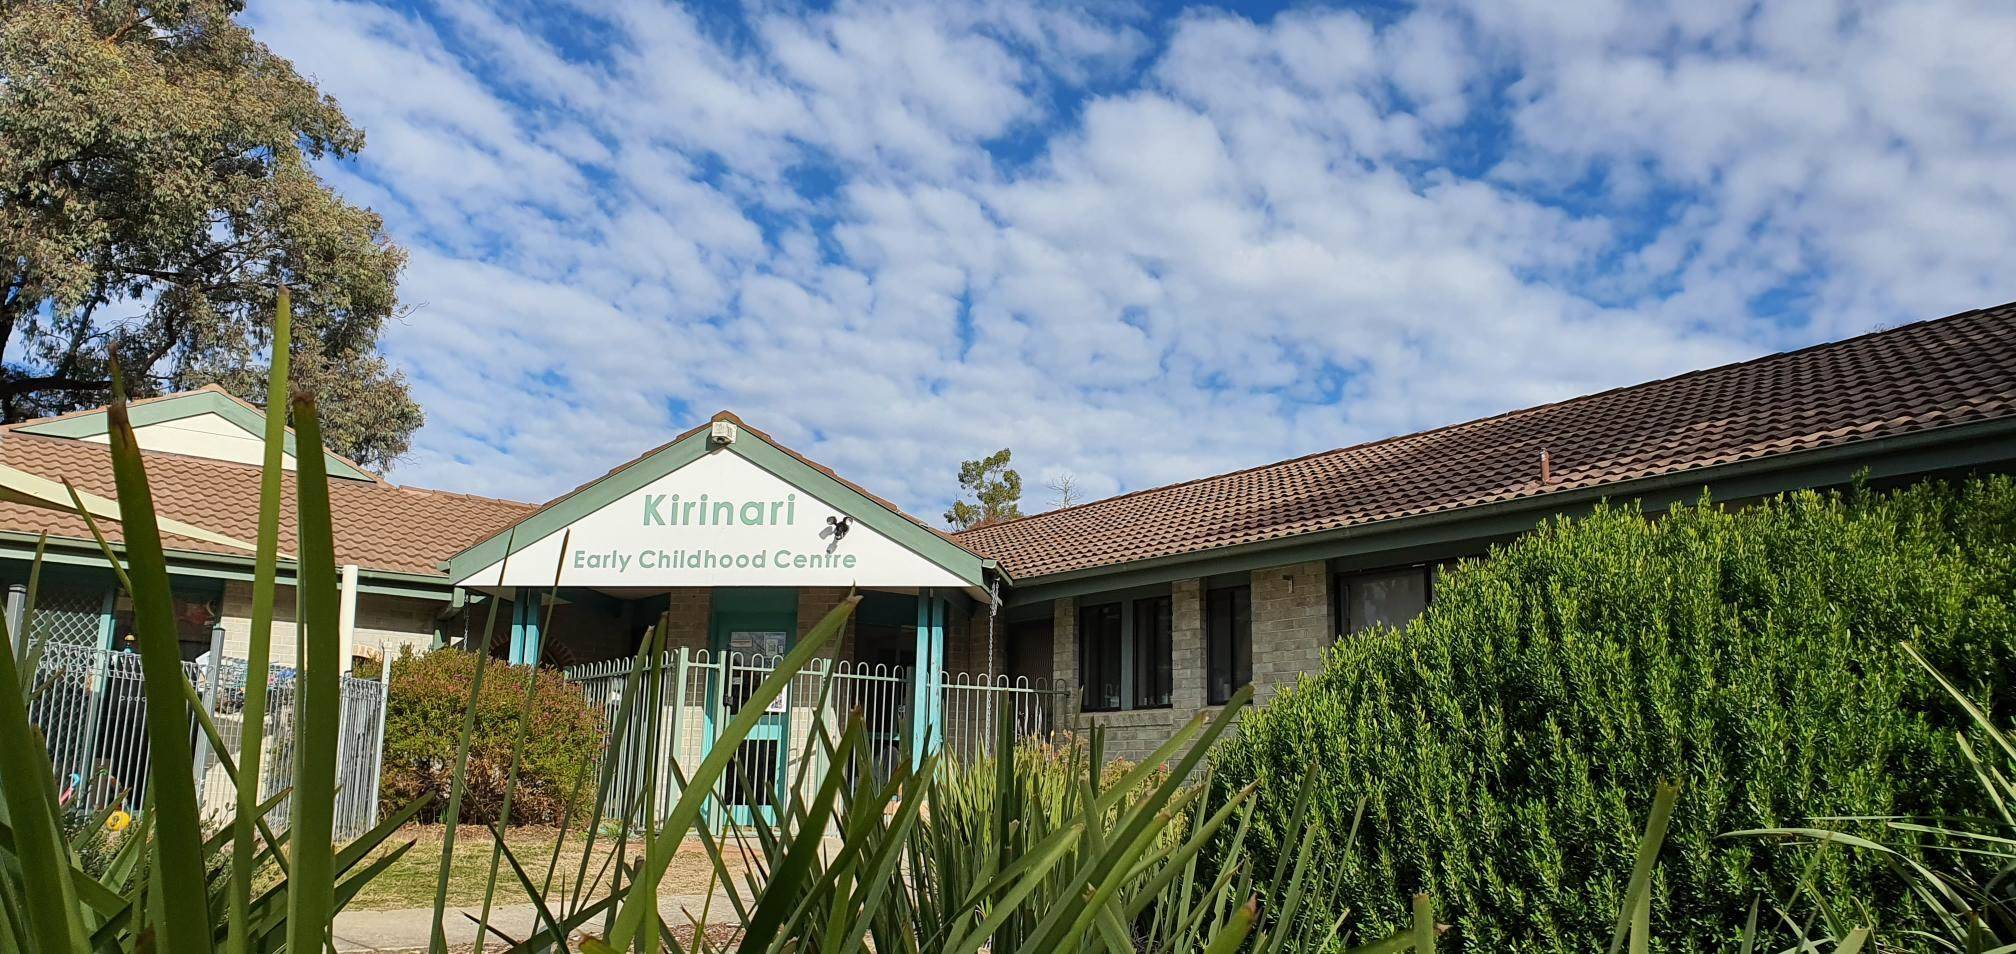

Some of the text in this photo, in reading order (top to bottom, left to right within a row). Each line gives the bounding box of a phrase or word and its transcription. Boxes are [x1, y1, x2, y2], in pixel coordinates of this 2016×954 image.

[643, 494, 796, 526] Kirinari
[574, 550, 857, 573] Early Childhood Centre
